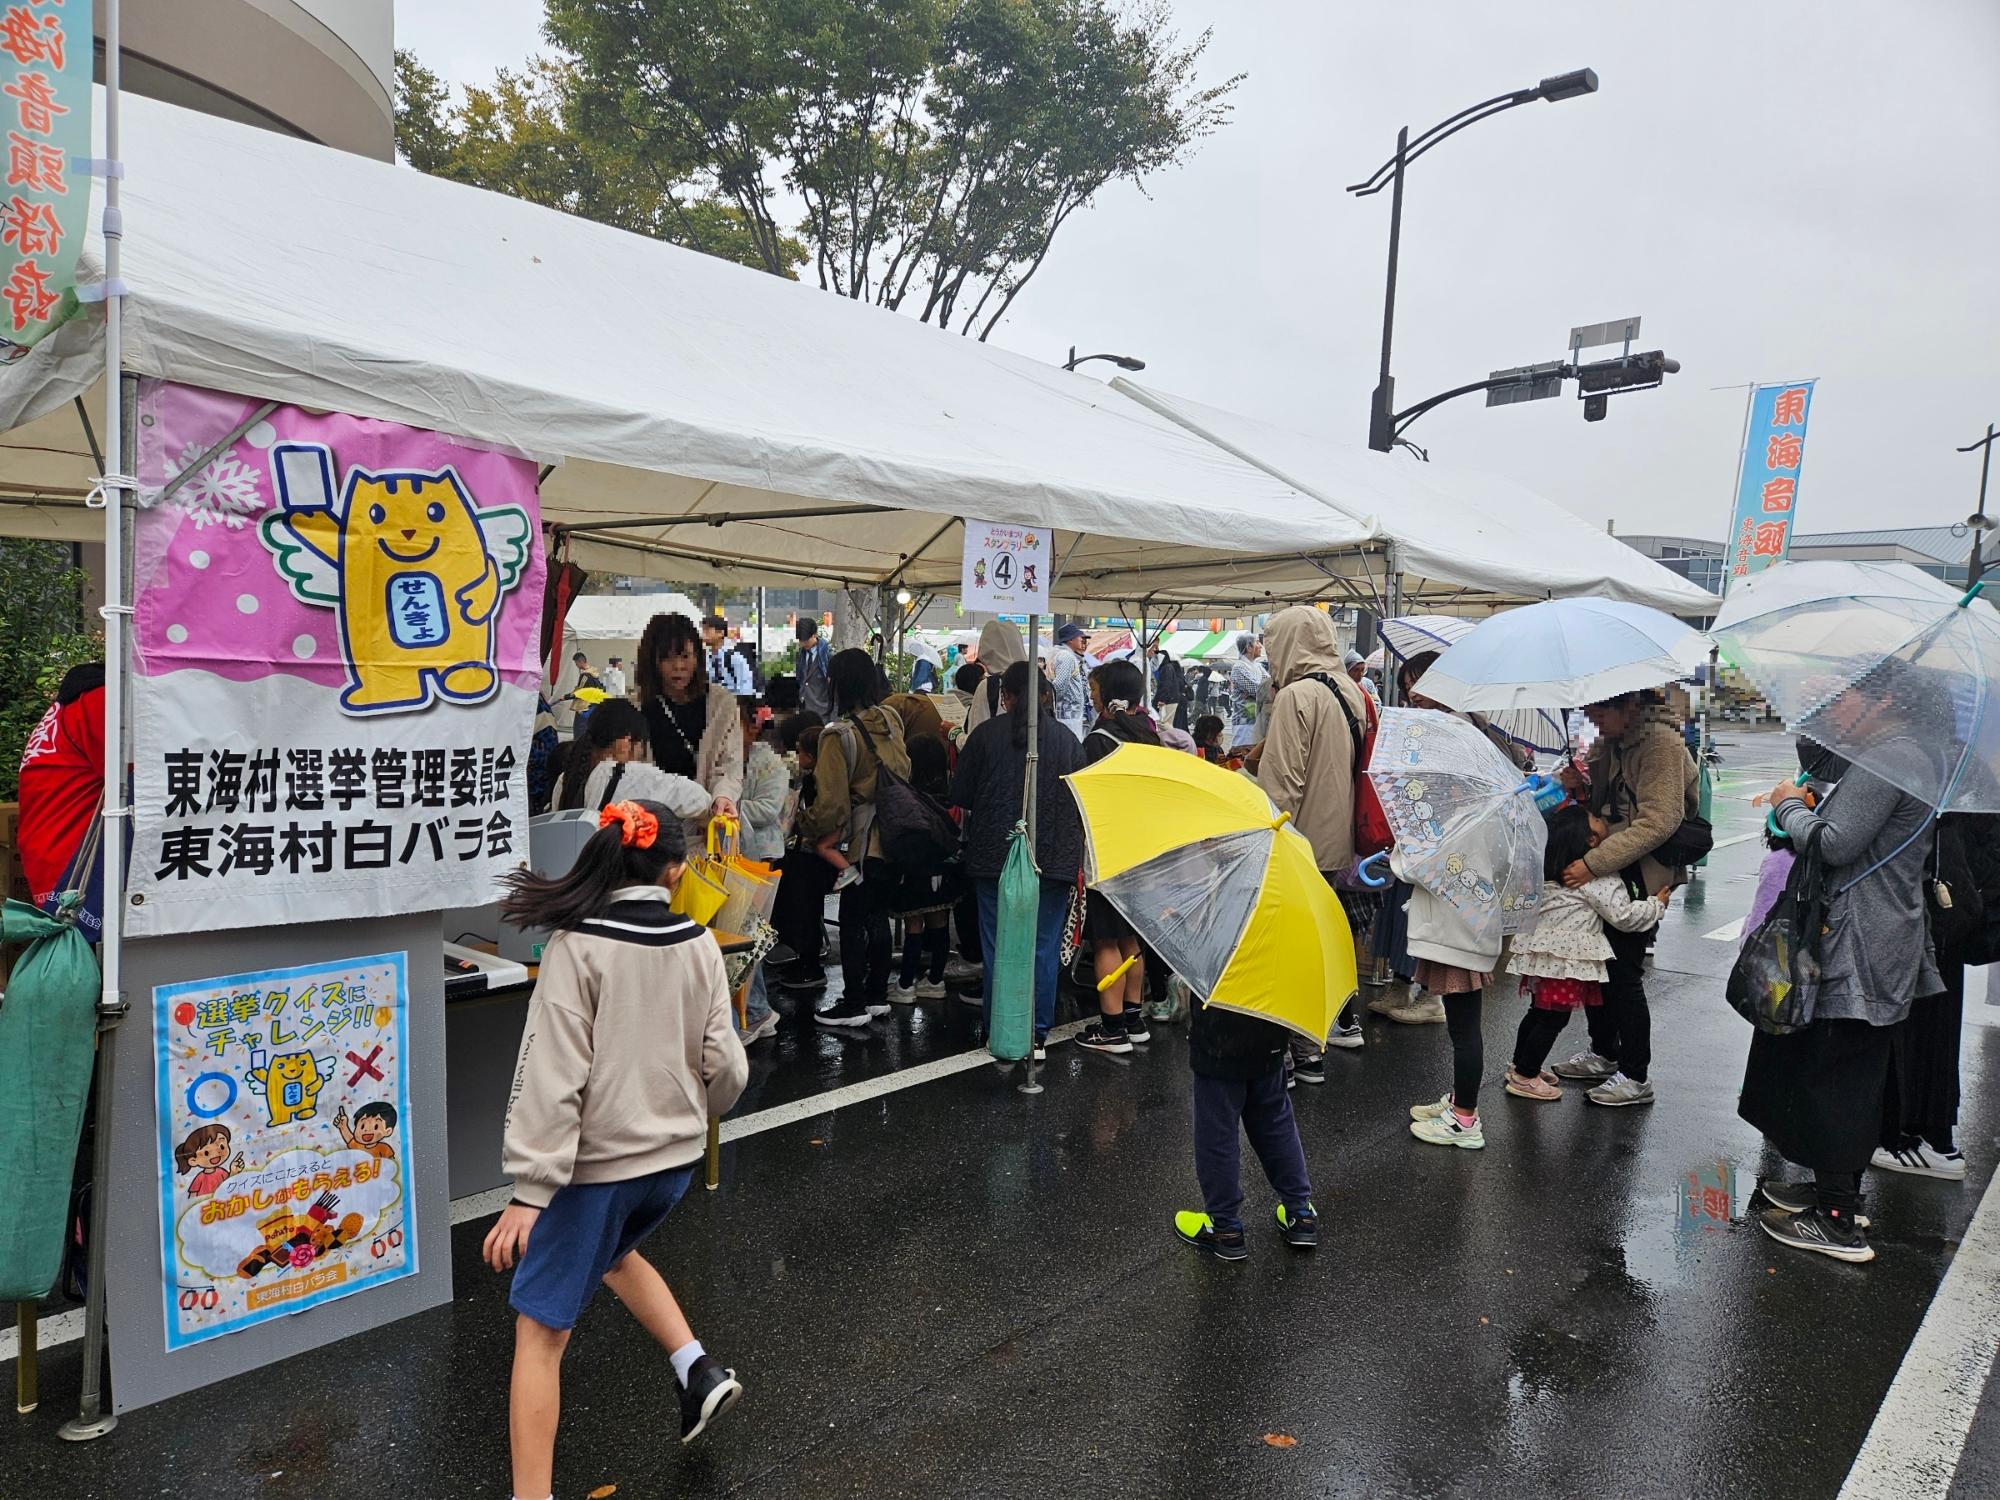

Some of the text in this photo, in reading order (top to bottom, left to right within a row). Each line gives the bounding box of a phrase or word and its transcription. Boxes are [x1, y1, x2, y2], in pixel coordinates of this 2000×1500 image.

[1752, 388, 1807, 557] 東海音頭
[1732, 518, 1753, 576] 東海音頭
[398, 580, 435, 639] せんきょ
[164, 746, 516, 818] 東海村選挙管理委員会
[154, 811, 513, 882] 東海村白バラ会
[197, 981, 367, 1030] 選挙クイズに
[200, 1158, 383, 1226] おかしがもらえる!
[226, 1159, 333, 1194] クイズにこたえると
